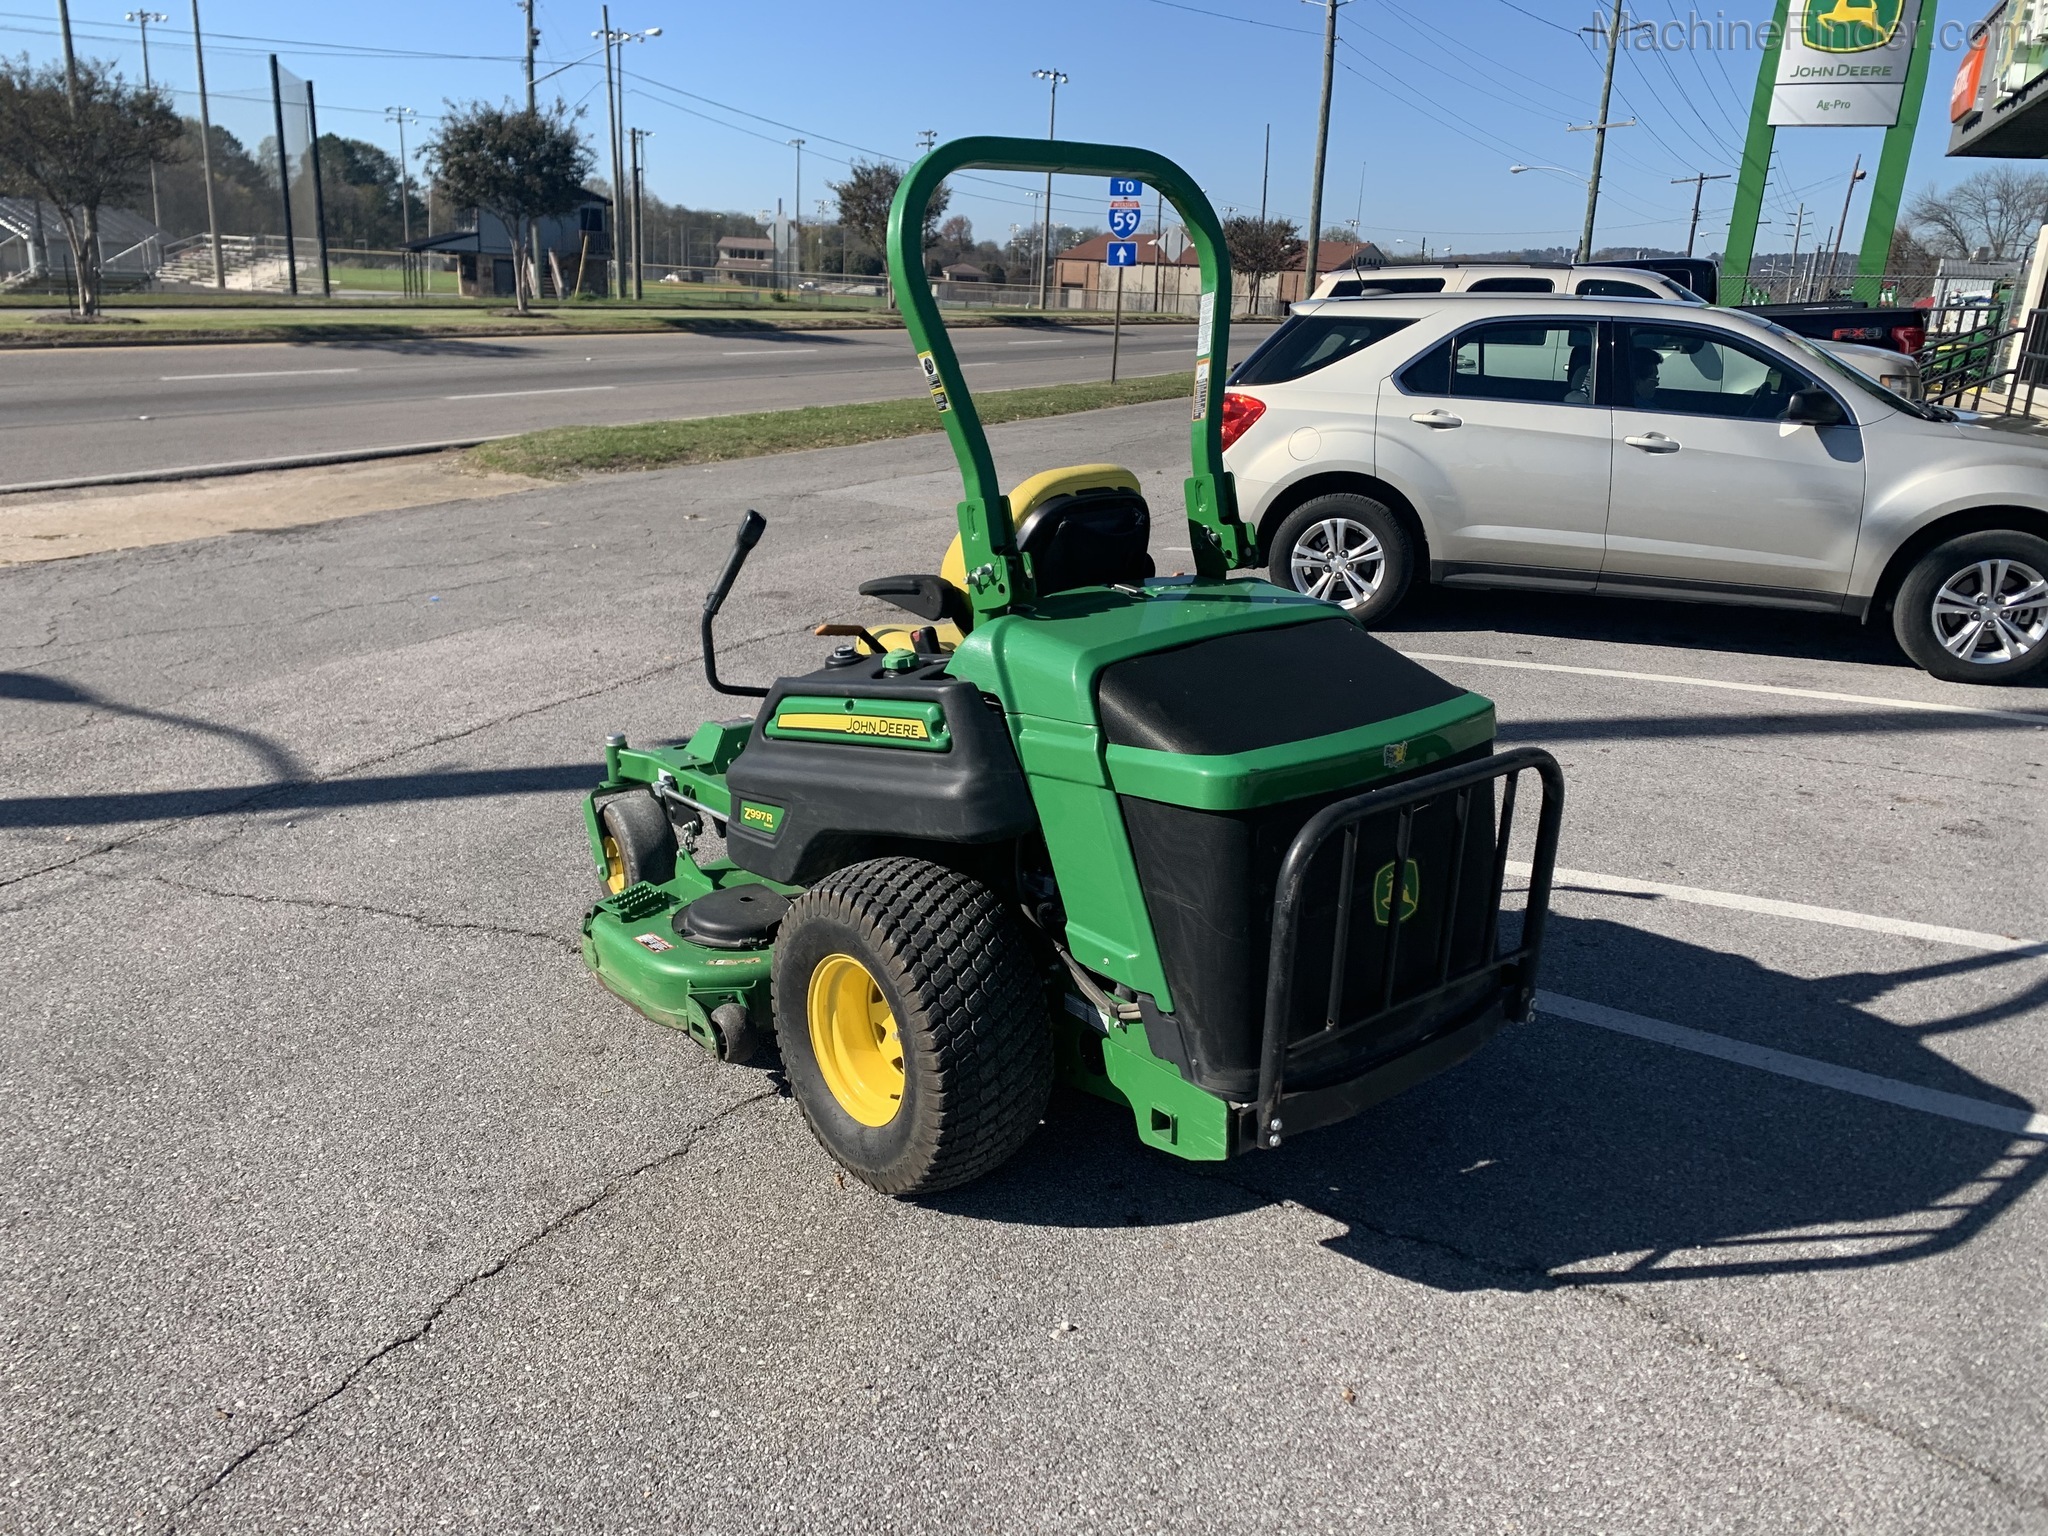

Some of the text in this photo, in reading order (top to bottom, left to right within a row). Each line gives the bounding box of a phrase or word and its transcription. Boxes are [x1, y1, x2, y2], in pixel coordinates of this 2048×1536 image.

[1790, 64, 1893, 77] JOHN DEERE
[1816, 99, 1851, 111] Ag-Pro
[1117, 181, 1135, 193] TO
[1113, 212, 1137, 231] 59
[846, 717, 919, 736] JOHN DEERE
[743, 806, 773, 823] Z997R
